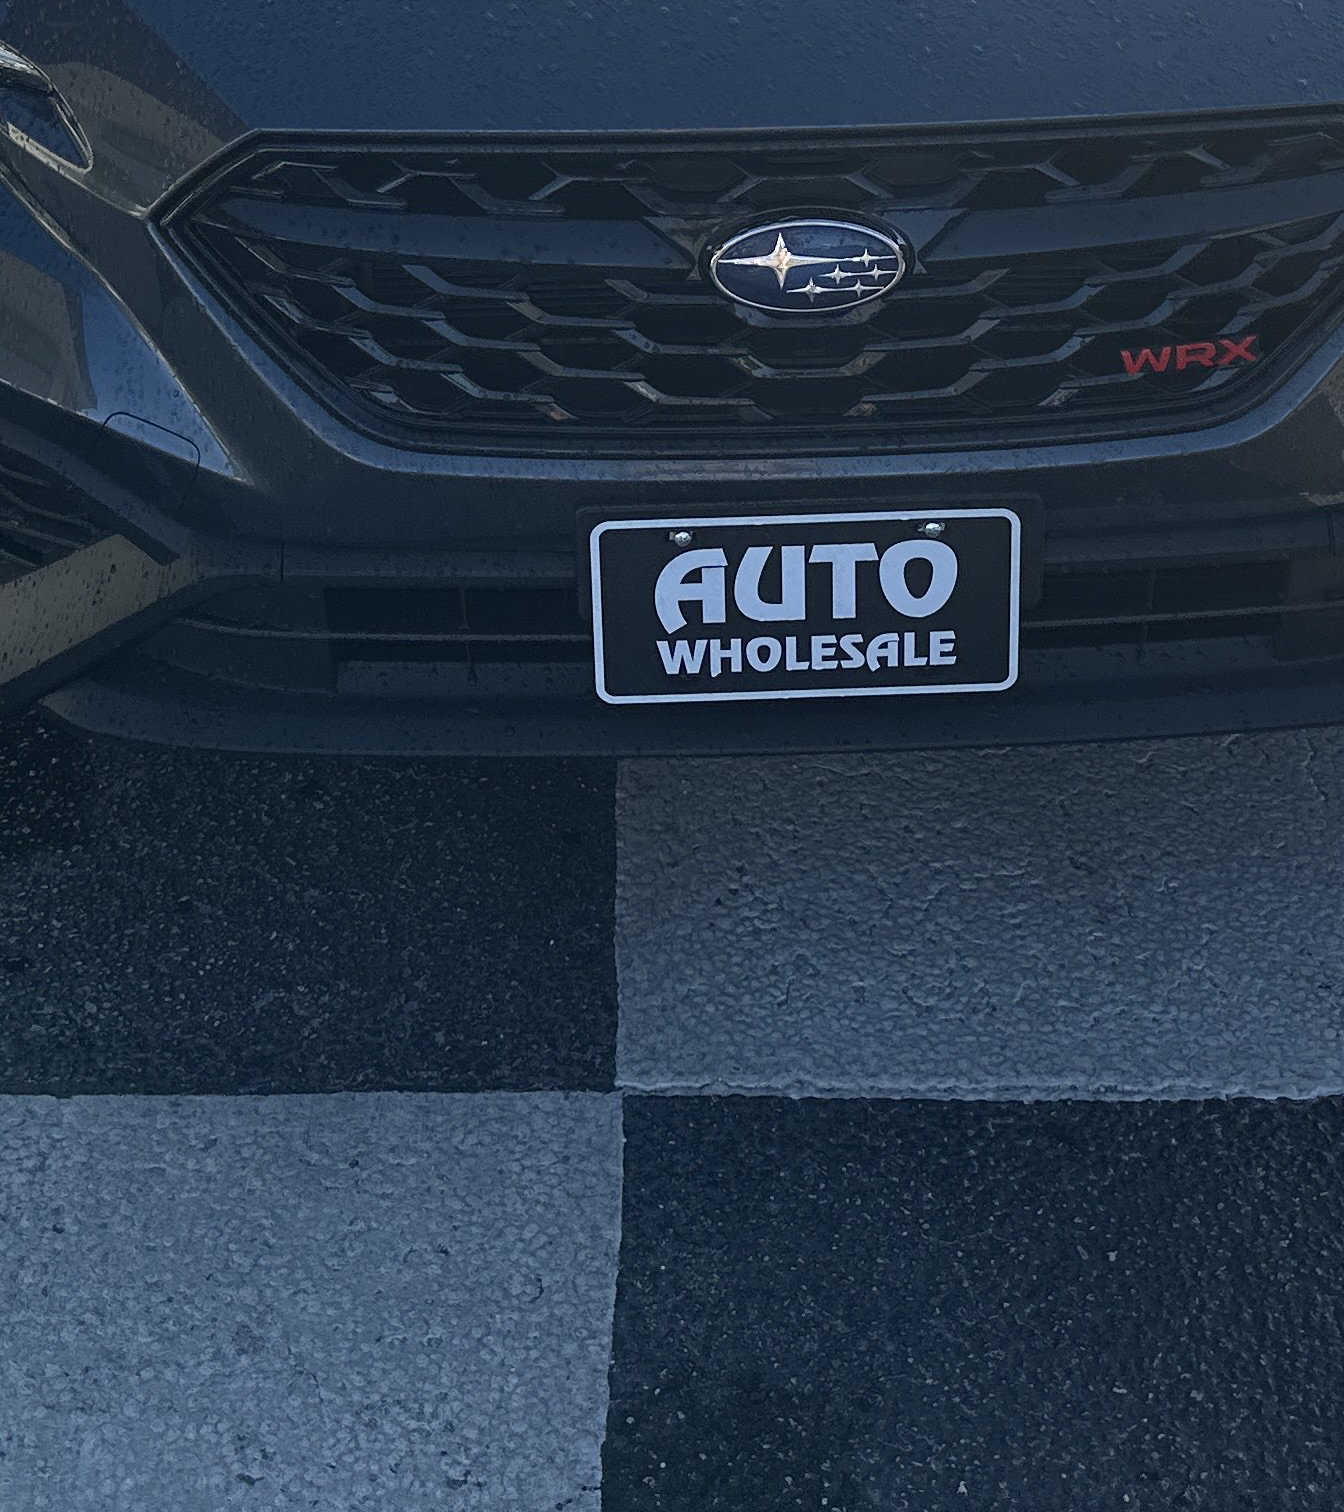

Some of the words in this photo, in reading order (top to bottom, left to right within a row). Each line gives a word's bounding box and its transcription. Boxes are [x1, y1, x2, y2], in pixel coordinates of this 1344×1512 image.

[1120, 335, 1258, 376] WRX
[655, 539, 958, 635] AUTO
[656, 630, 958, 678] WHOLESALE
